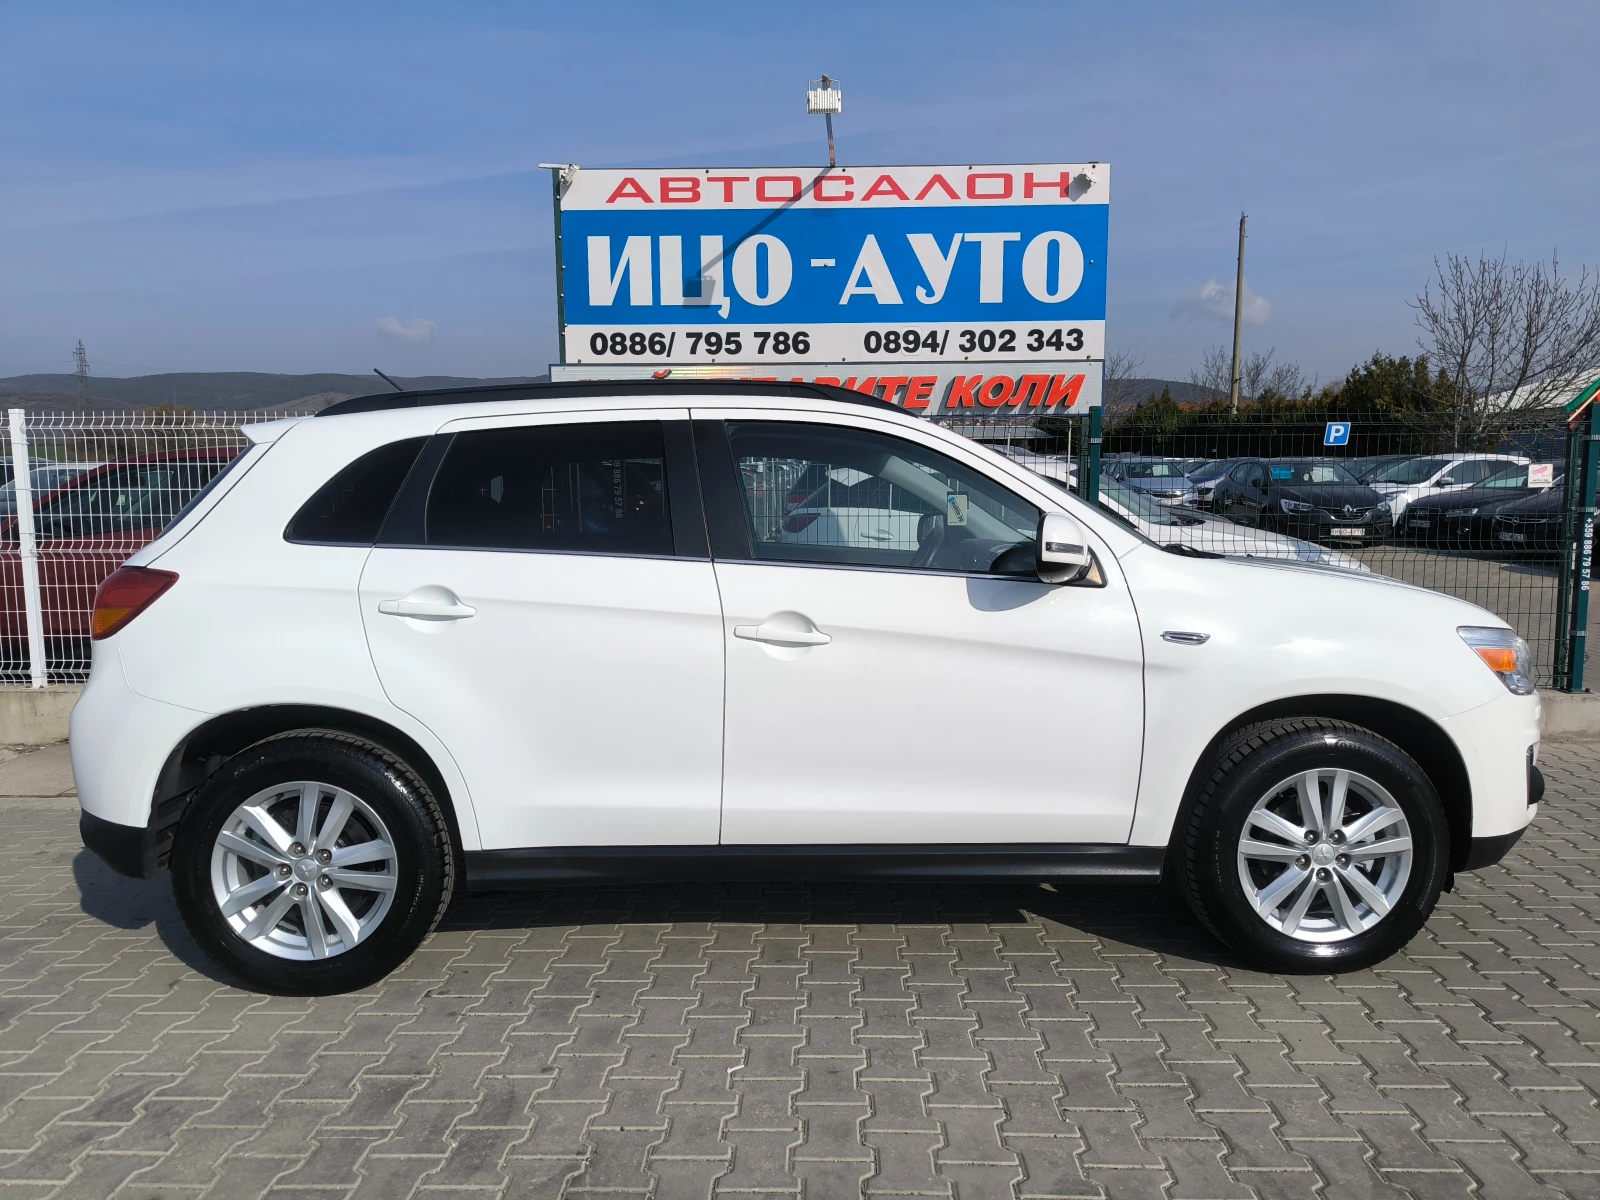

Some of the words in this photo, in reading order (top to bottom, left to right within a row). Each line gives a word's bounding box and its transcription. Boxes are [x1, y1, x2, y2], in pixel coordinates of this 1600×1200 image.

[607, 173, 1069, 204] АВТОСАЛОН
[590, 332, 676, 358] 0886/
[686, 331, 743, 356] 795
[753, 331, 811, 356] 786
[863, 330, 950, 356] 0894/
[959, 329, 1016, 353] 302
[1026, 328, 1084, 352] 343
[947, 374, 1086, 408] КОЛИ
[1329, 425, 1345, 443] P
[613, 469, 622, 484] 886
[614, 485, 622, 495] 79
[614, 497, 623, 507] 57
[615, 508, 624, 518] 86
[1584, 517, 1594, 538] +359
[1583, 540, 1593, 555] 886
[1582, 556, 1592, 567] 79
[1581, 568, 1591, 579] 57
[1581, 580, 1590, 591] 86
